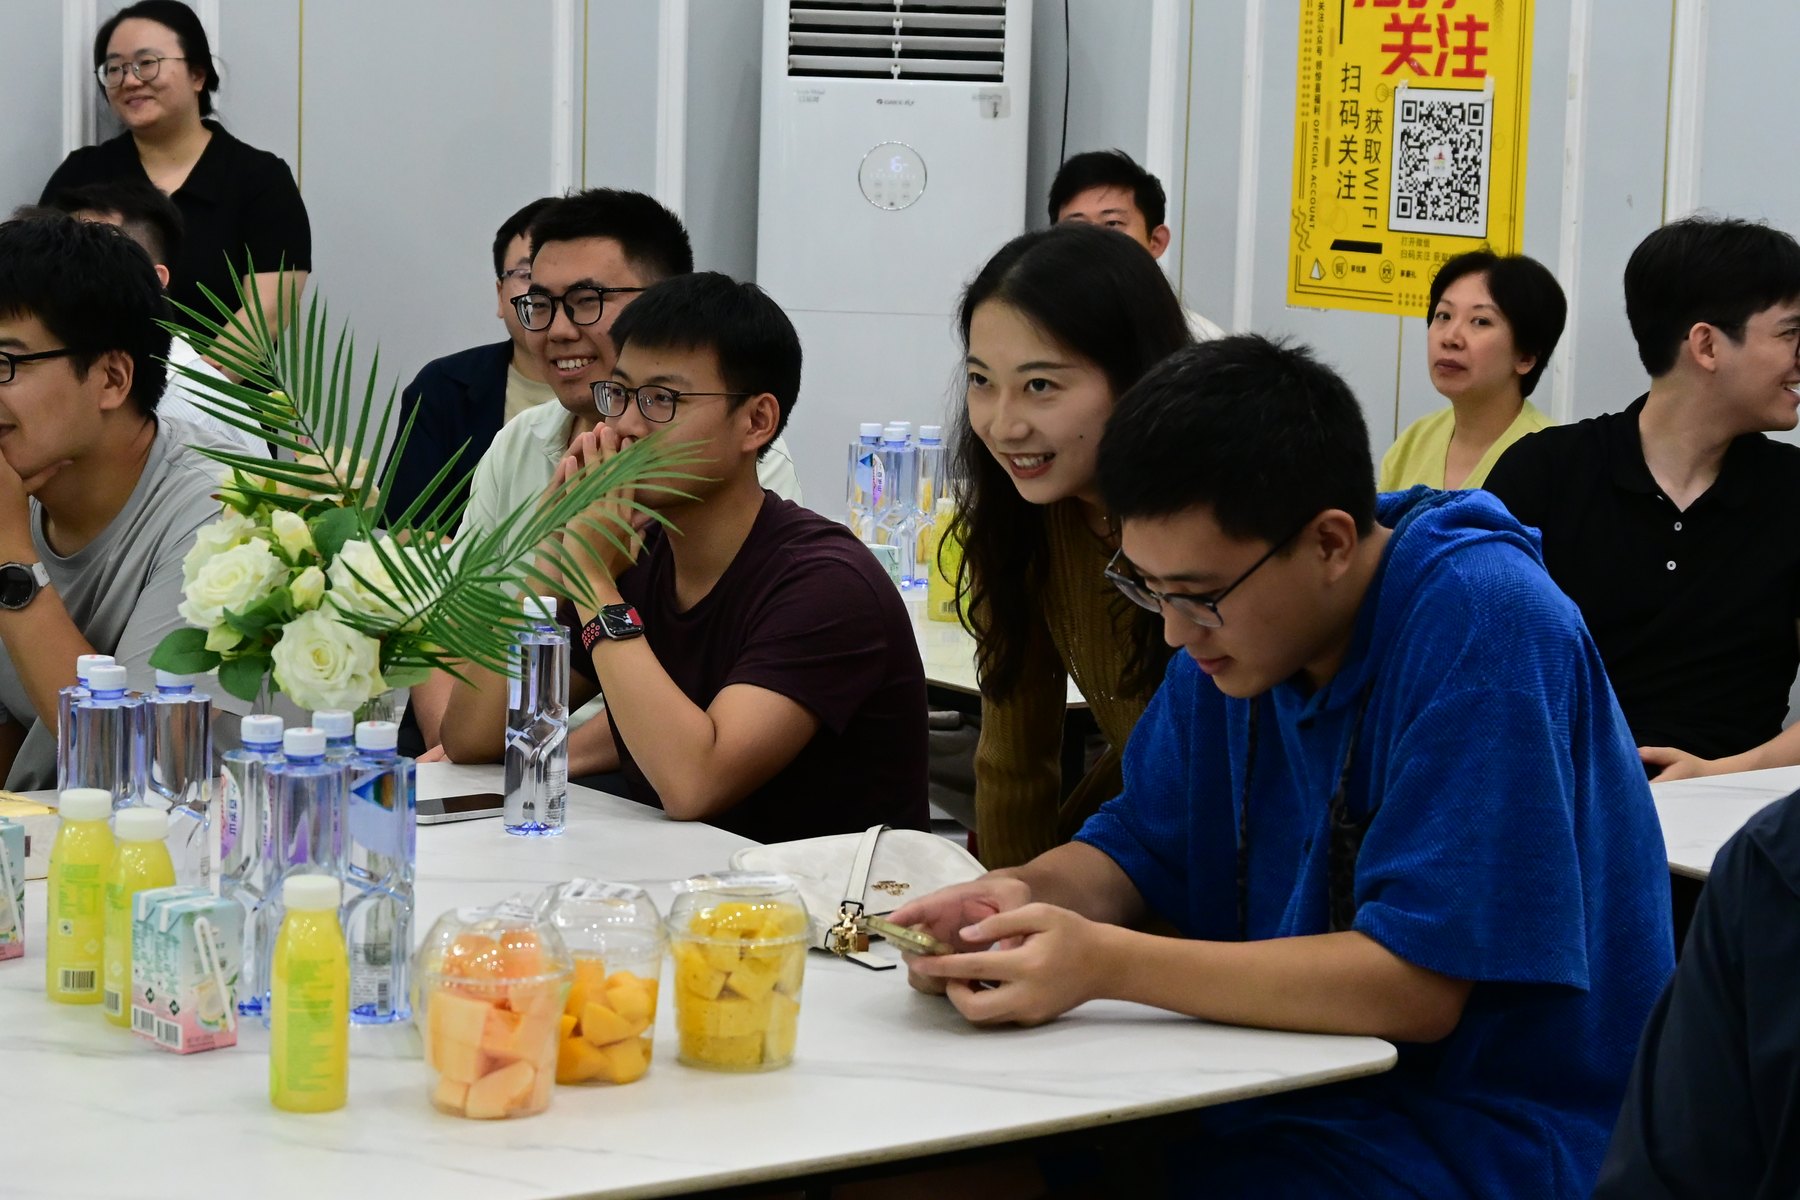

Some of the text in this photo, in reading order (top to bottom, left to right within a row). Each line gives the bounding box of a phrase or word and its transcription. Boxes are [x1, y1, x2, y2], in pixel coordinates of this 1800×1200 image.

[1381, 12, 1489, 78] 关注
[1311, 120, 1320, 170] OFFICIAL
[1336, 62, 1361, 200] 扫码关注
[1309, 174, 1317, 229] ACCOUNT
